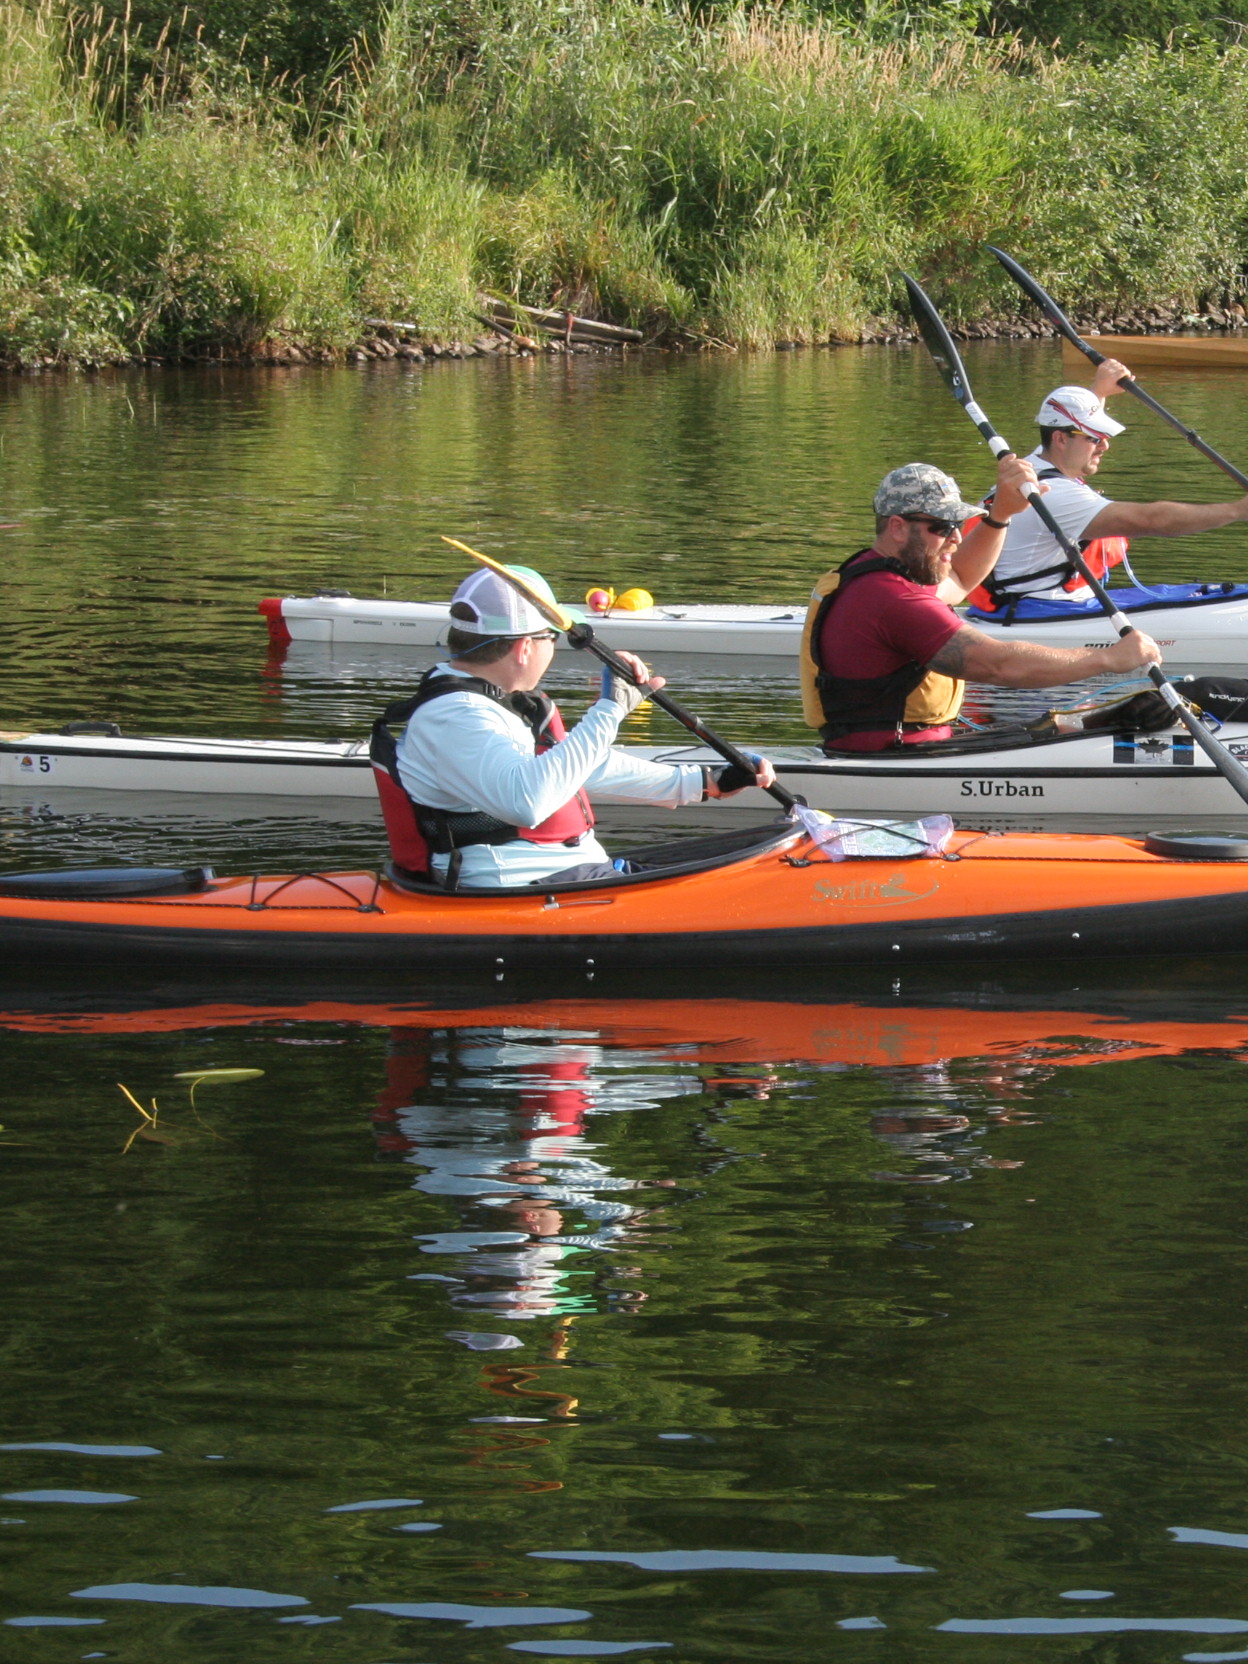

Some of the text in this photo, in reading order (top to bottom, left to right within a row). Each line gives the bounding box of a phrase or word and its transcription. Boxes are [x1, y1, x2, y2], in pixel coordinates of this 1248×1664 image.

[39, 755, 51, 773] 5
[960, 780, 1045, 797] S.Urban
[812, 878, 879, 902] Swift
